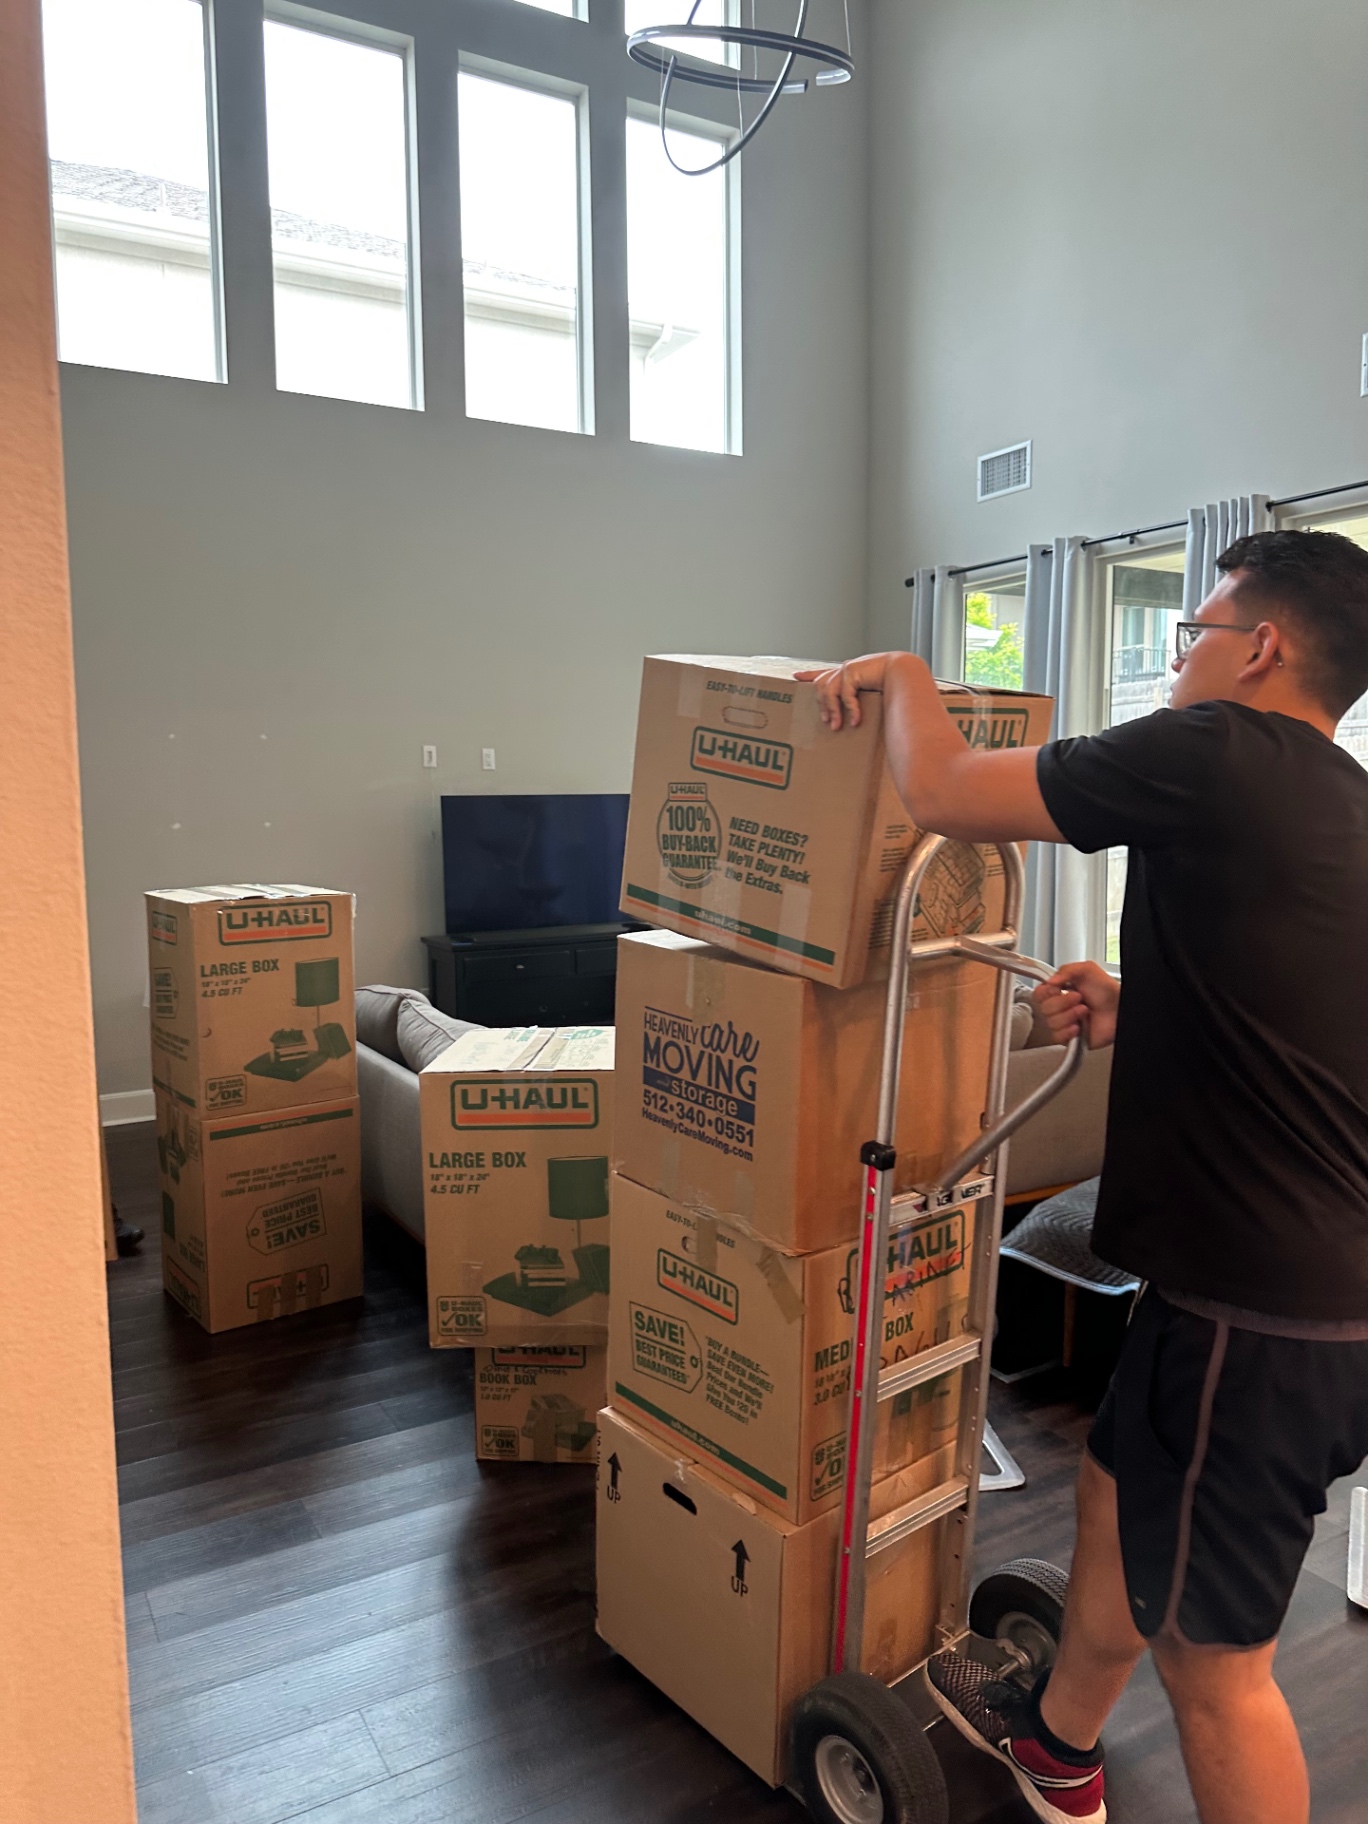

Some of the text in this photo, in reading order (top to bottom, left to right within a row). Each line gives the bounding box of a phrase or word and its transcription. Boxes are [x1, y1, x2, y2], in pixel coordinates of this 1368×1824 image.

[706, 680, 755, 698] EASY-TO-LIFT
[957, 720, 1018, 749] HAUL
[698, 734, 785, 772] U-HAUL
[670, 785, 705, 794] U-HAUL
[666, 805, 711, 833] 100%
[729, 816, 809, 848] NEED BOXES?
[662, 834, 717, 853] BUY-BACK
[728, 833, 806, 865] TAKE PLENTY!
[726, 866, 743, 882] the
[745, 871, 783, 895] Extras.
[727, 849, 811, 884] We'll Buy Back
[226, 906, 325, 930] U-HAUL
[200, 958, 279, 978] LARGE BOX
[644, 1011, 760, 1063] HEAVENLY care
[643, 1031, 757, 1101] MOVING
[461, 1087, 589, 1110] U-HAUL
[671, 1079, 739, 1116] storage
[642, 1106, 753, 1162] HeavenlyCareMoving.com
[429, 1151, 527, 1168] LARGE BOX
[430, 1184, 480, 1194] 4.5 CU FT
[264, 1203, 318, 1230] BEST PRICE
[266, 1219, 321, 1250] SAVE!
[887, 1225, 958, 1273] HAUL
[662, 1256, 734, 1308] U-HAUL
[455, 1313, 482, 1327] OK
[634, 1310, 685, 1347] SAVE!
[635, 1339, 686, 1370] BEST PRICE
[814, 1339, 853, 1372] MED
[884, 1312, 914, 1342] BOX
[479, 1372, 537, 1386] BOOK BOX
[606, 1486, 622, 1504] UP
[730, 1575, 749, 1598] UP
